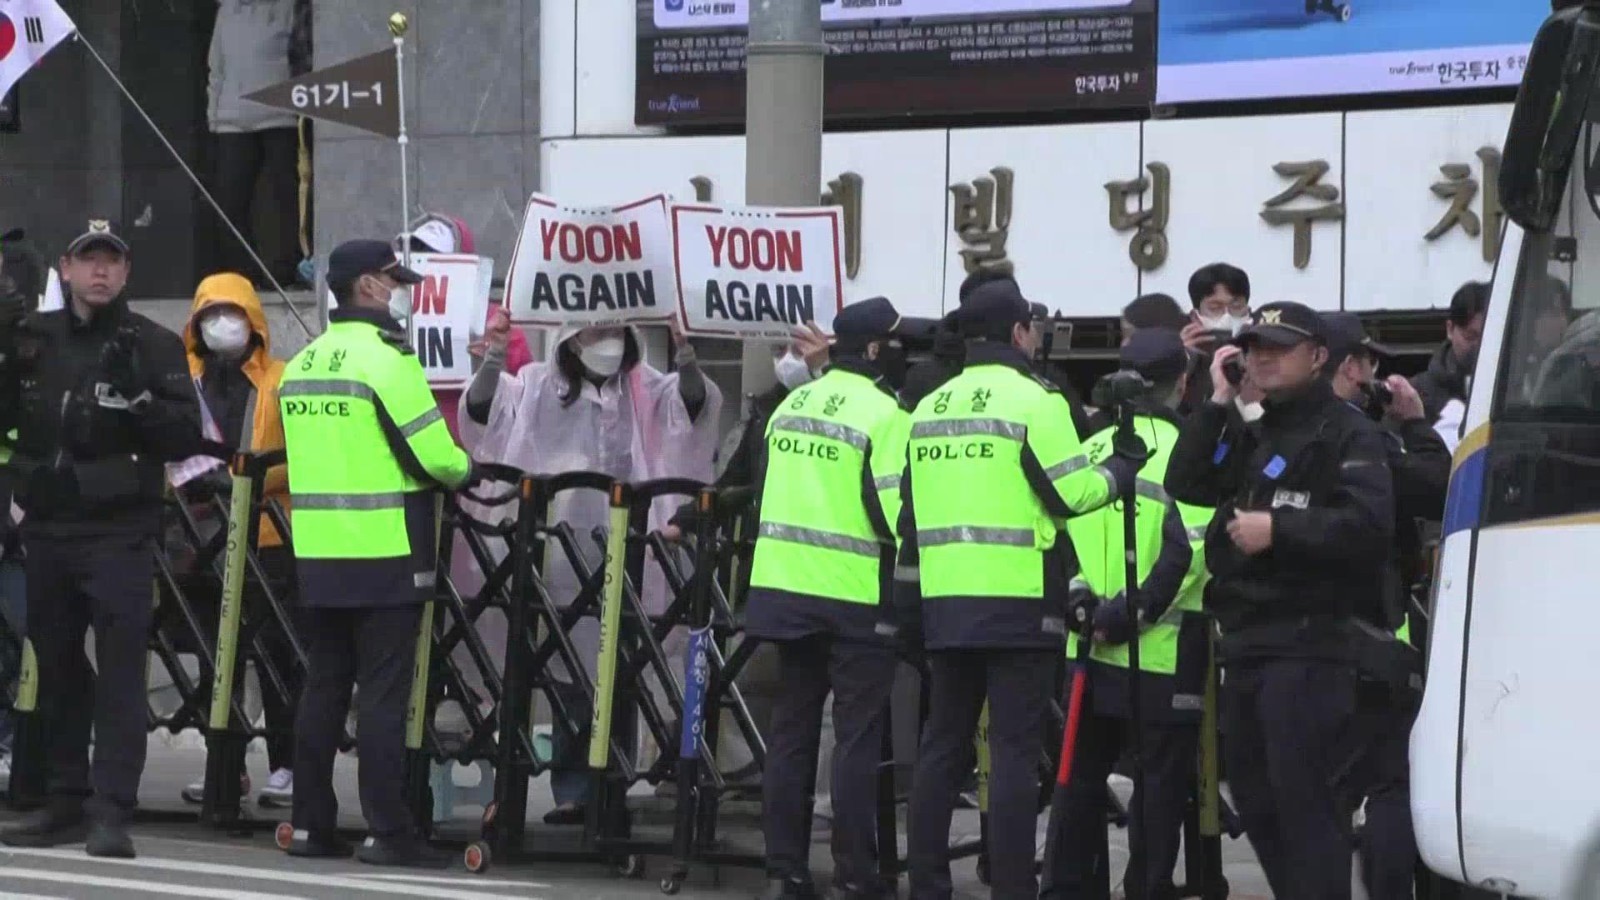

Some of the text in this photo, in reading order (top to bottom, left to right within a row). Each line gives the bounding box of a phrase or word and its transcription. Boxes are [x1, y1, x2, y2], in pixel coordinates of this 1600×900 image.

[1438, 60, 1500, 84] 한국투자
[291, 80, 382, 108] 61기-1
[540, 219, 643, 263] YOON
[705, 225, 803, 272] YOON
[530, 270, 656, 311] AGAIN
[705, 280, 814, 325] AGAIN
[301, 348, 346, 372] 경찰
[285, 400, 350, 417] POLICE
[791, 389, 846, 417] 경찰
[934, 387, 992, 414] 경찰
[772, 437, 839, 462] OLICE
[916, 442, 995, 462] POLICE
